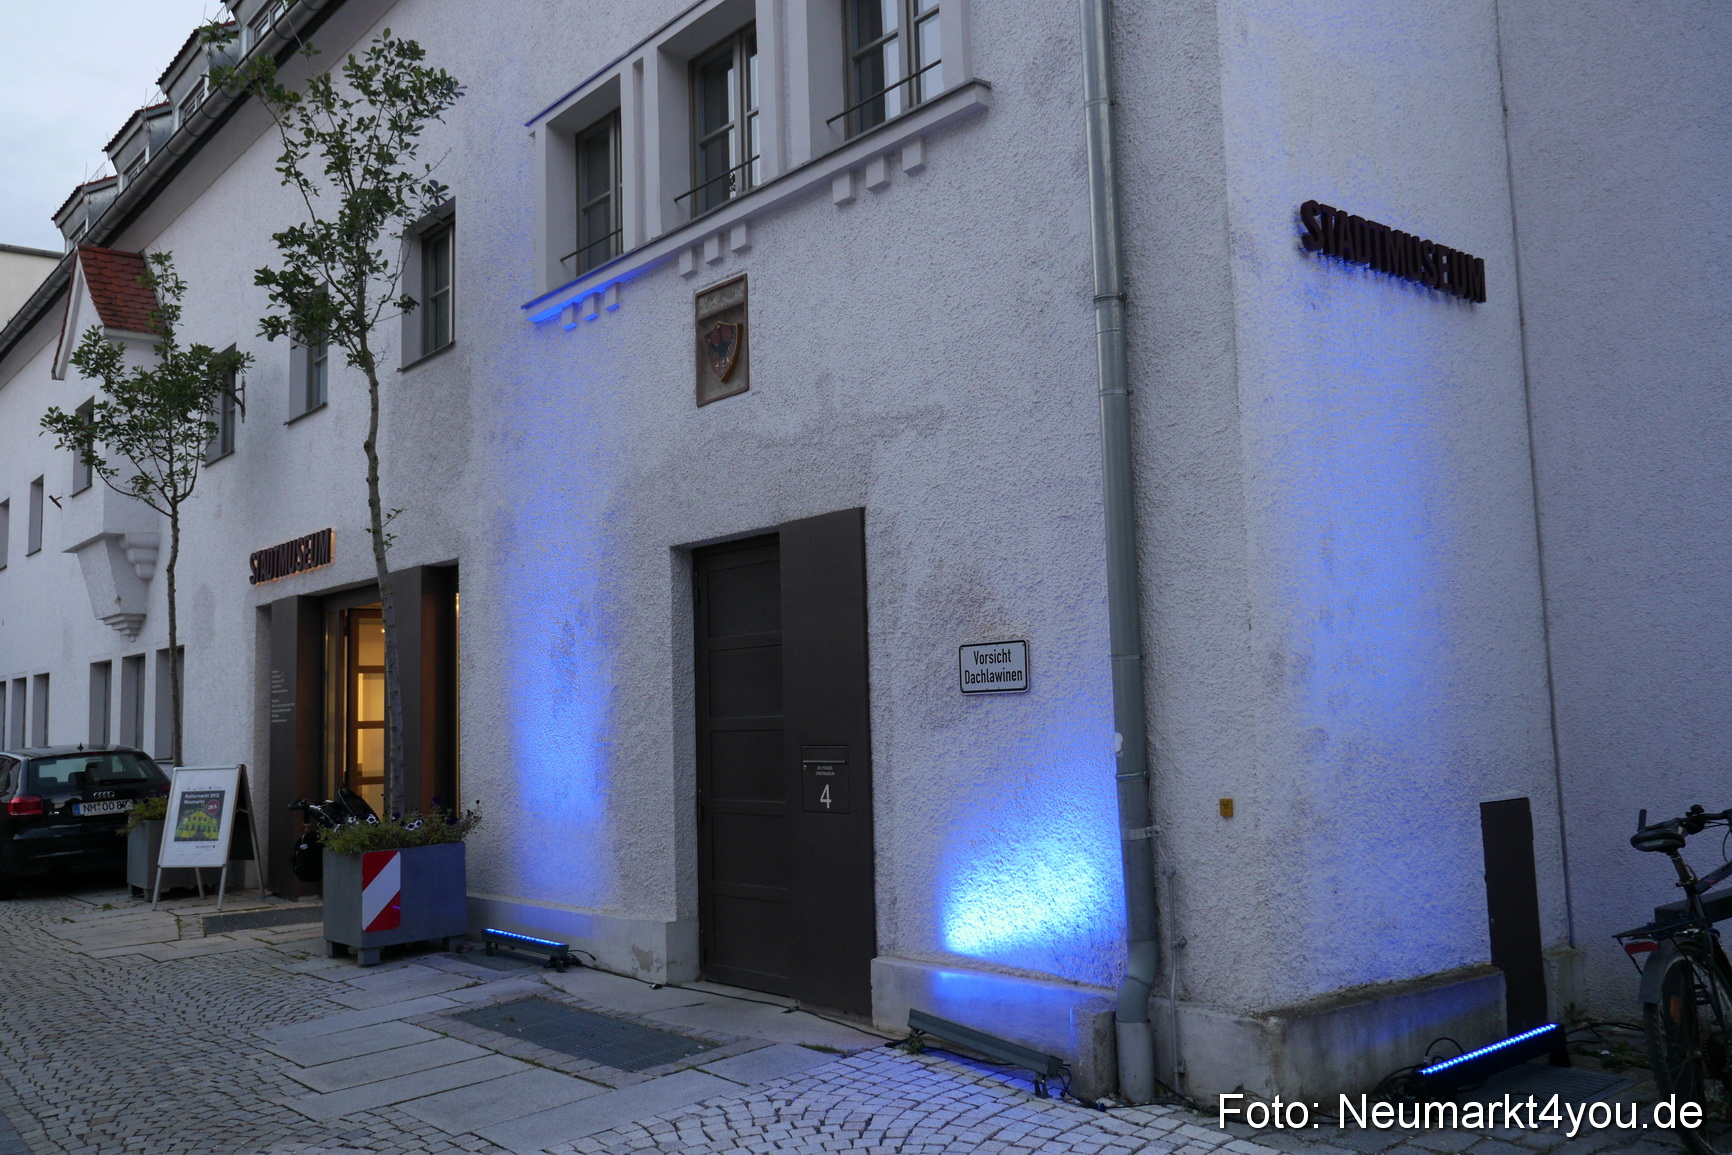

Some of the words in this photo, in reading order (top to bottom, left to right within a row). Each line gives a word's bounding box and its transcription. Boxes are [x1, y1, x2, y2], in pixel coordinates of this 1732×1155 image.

[1300, 200, 1486, 304] STADTMUSEUM
[249, 528, 332, 585] STADTMUSEUM
[973, 648, 1012, 665] Vorsicht
[964, 667, 1023, 685] Dachlawinen
[820, 784, 832, 808] 4
[83, 803, 97, 813] NM
